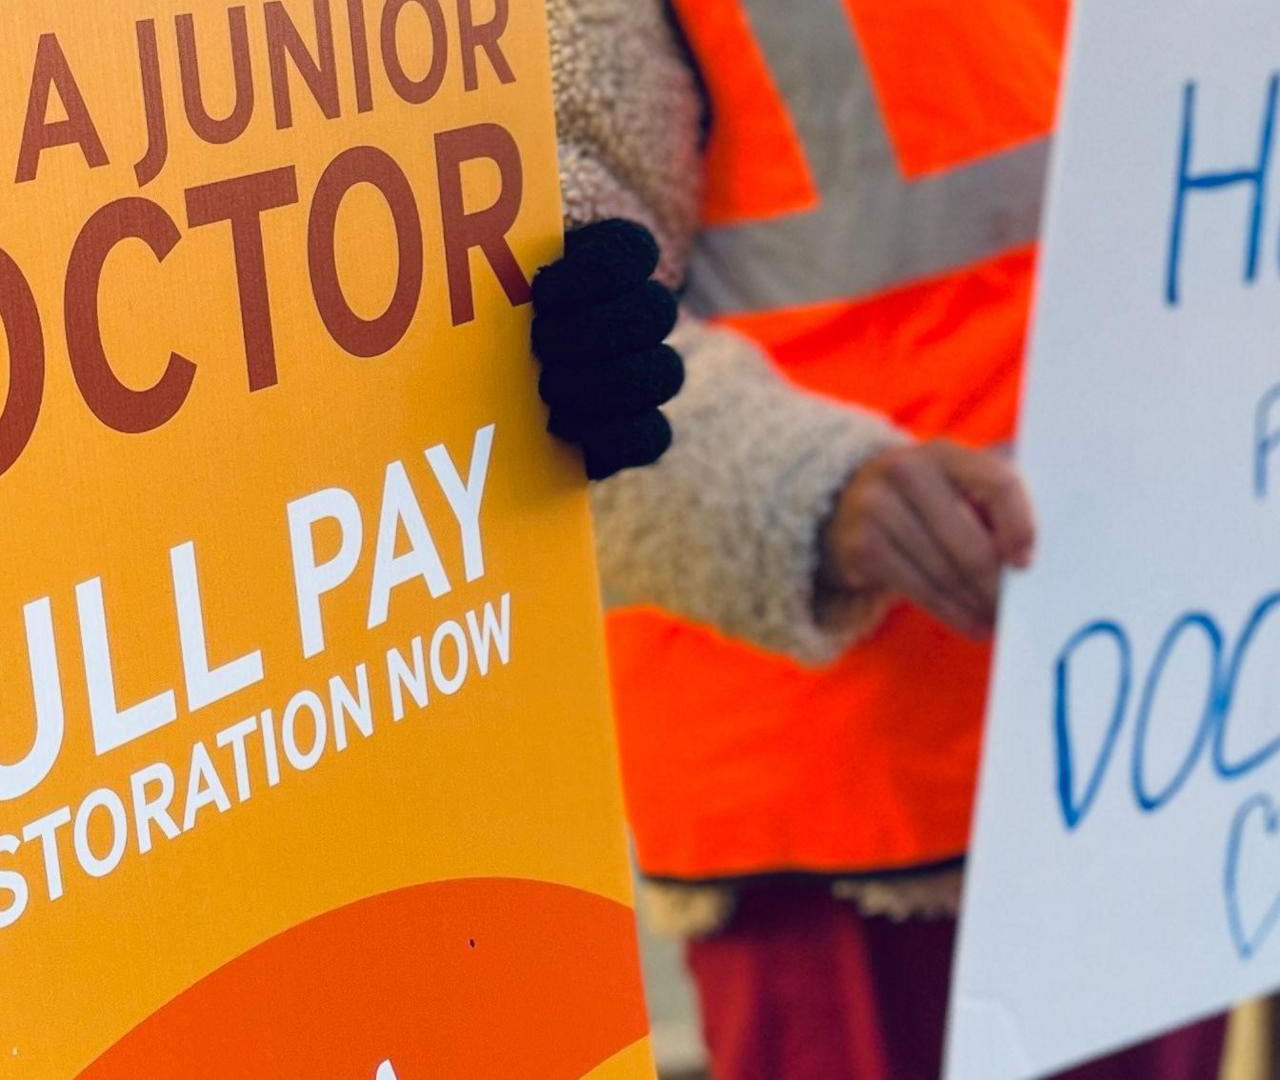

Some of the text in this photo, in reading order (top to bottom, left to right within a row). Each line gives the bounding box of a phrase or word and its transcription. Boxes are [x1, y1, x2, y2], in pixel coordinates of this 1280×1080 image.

[14, 32, 110, 184] A
[286, 423, 497, 659] PAY
[385, 592, 513, 722] NOW
